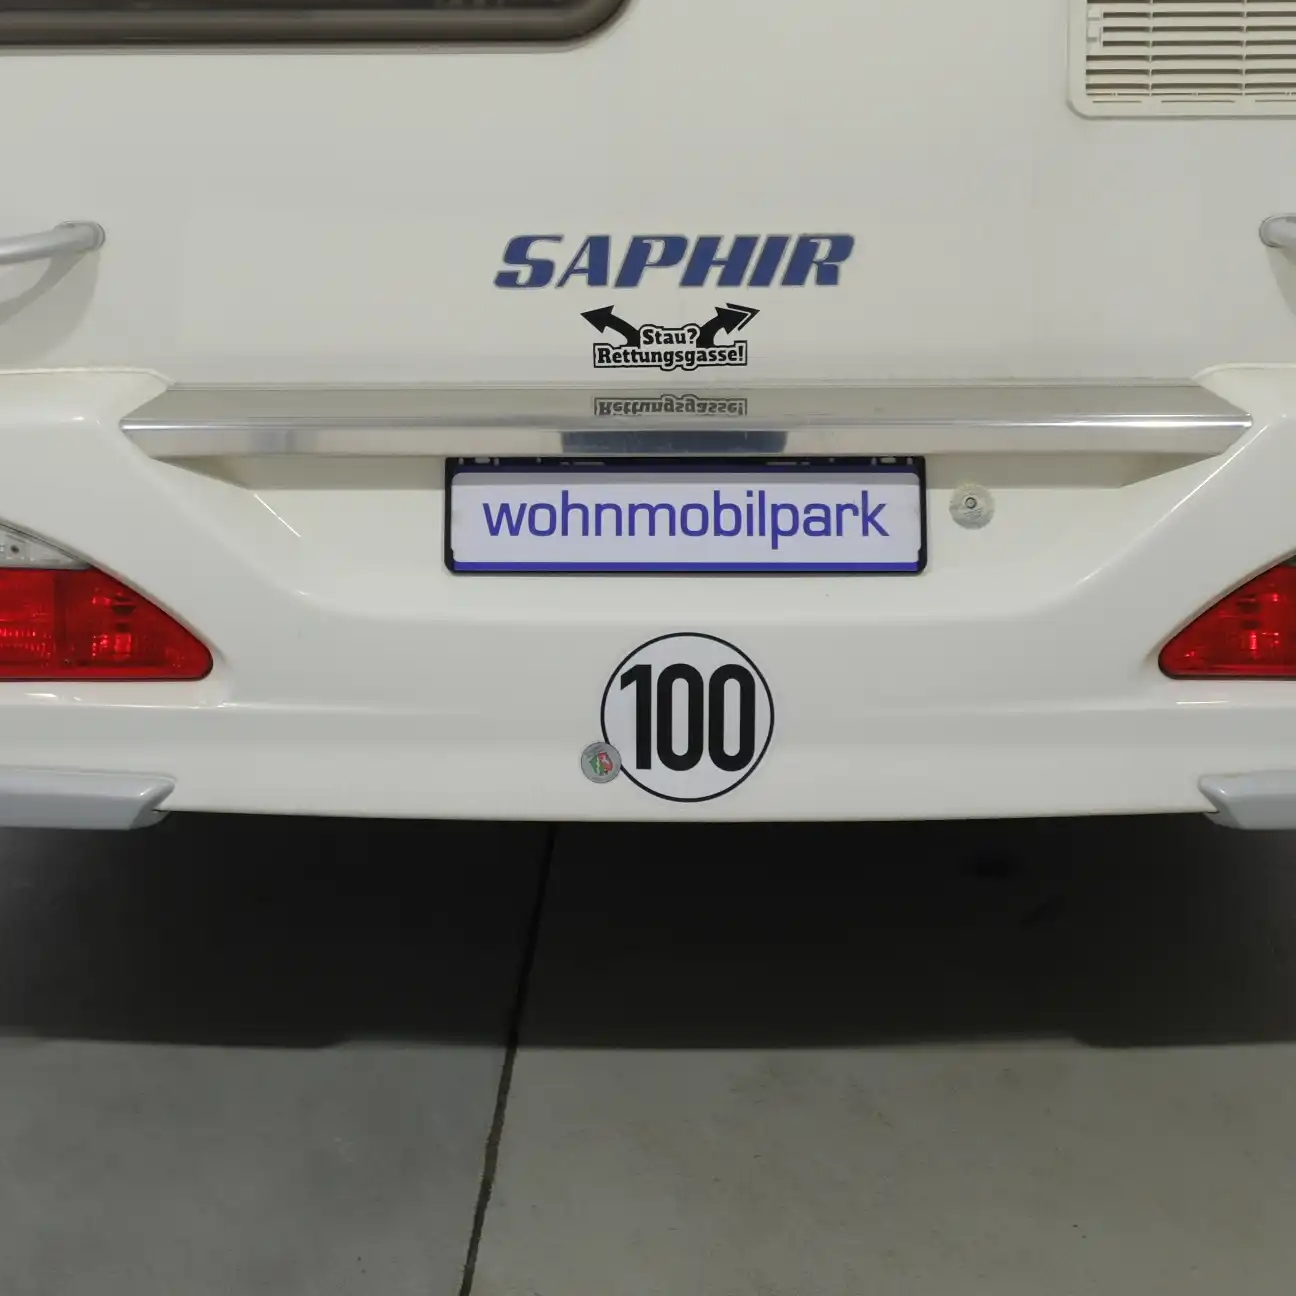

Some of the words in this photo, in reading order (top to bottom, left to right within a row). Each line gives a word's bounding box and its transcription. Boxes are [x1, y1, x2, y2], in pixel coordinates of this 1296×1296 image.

[493, 234, 855, 288] SAPHIR
[597, 346, 744, 366] Rettungsgasse!
[642, 327, 698, 345] Stau?
[482, 489, 890, 550] wohnmobilpark
[620, 663, 755, 772] 100
